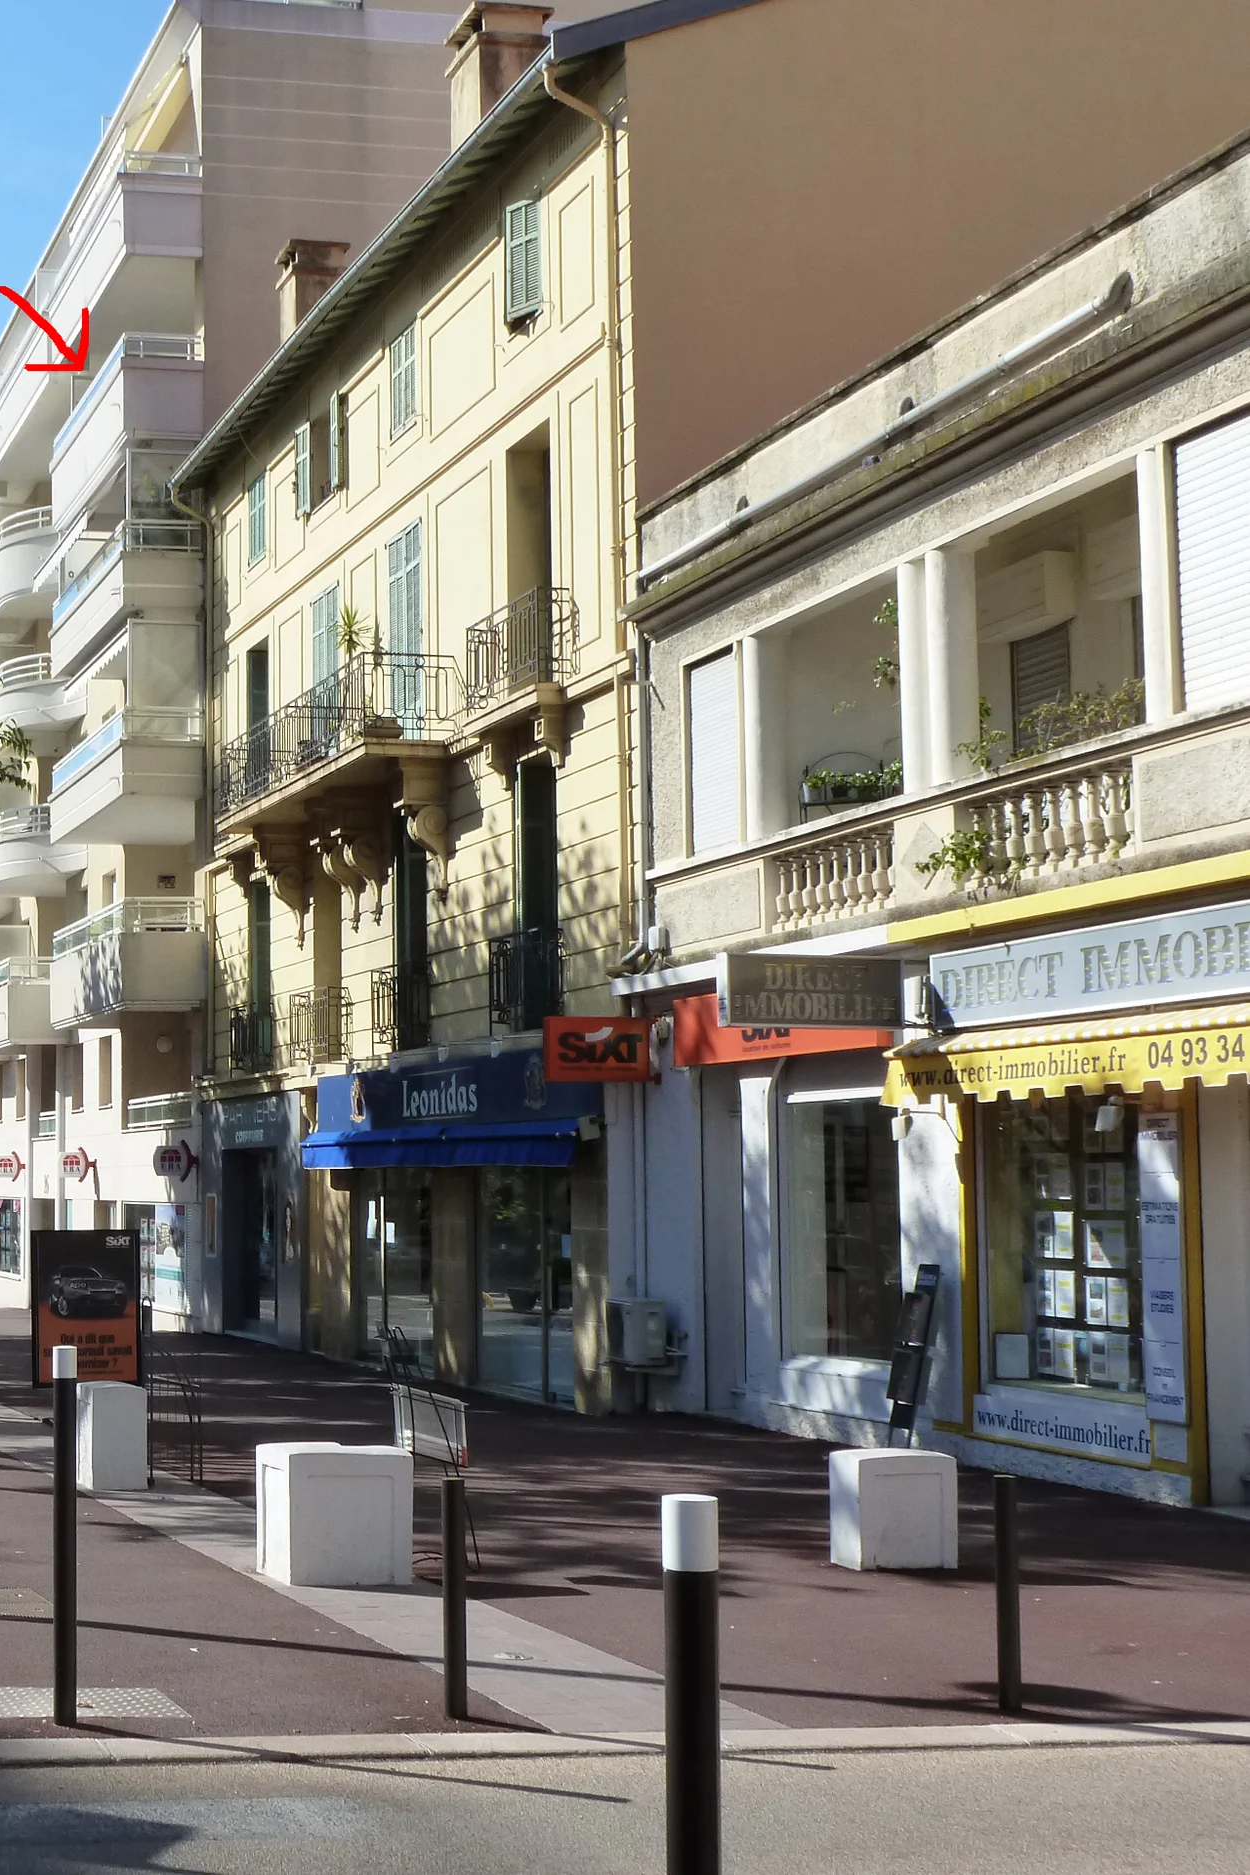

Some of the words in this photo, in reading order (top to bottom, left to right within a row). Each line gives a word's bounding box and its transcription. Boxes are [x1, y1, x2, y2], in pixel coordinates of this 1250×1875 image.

[764, 963, 867, 991] DIRECT
[939, 951, 1063, 1013] DIRECT
[734, 991, 897, 1021] IMMOBILIER
[900, 1046, 1126, 1087] www.direct-immobilier.fr
[1148, 1040, 1174, 1069] 04
[1181, 1036, 1207, 1067] 93
[1216, 1033, 1245, 1063] 34
[402, 1073, 478, 1117] Leonidas
[161, 1162, 181, 1171] ERA
[977, 1409, 1151, 1454] www.direct-immobilier.fr
